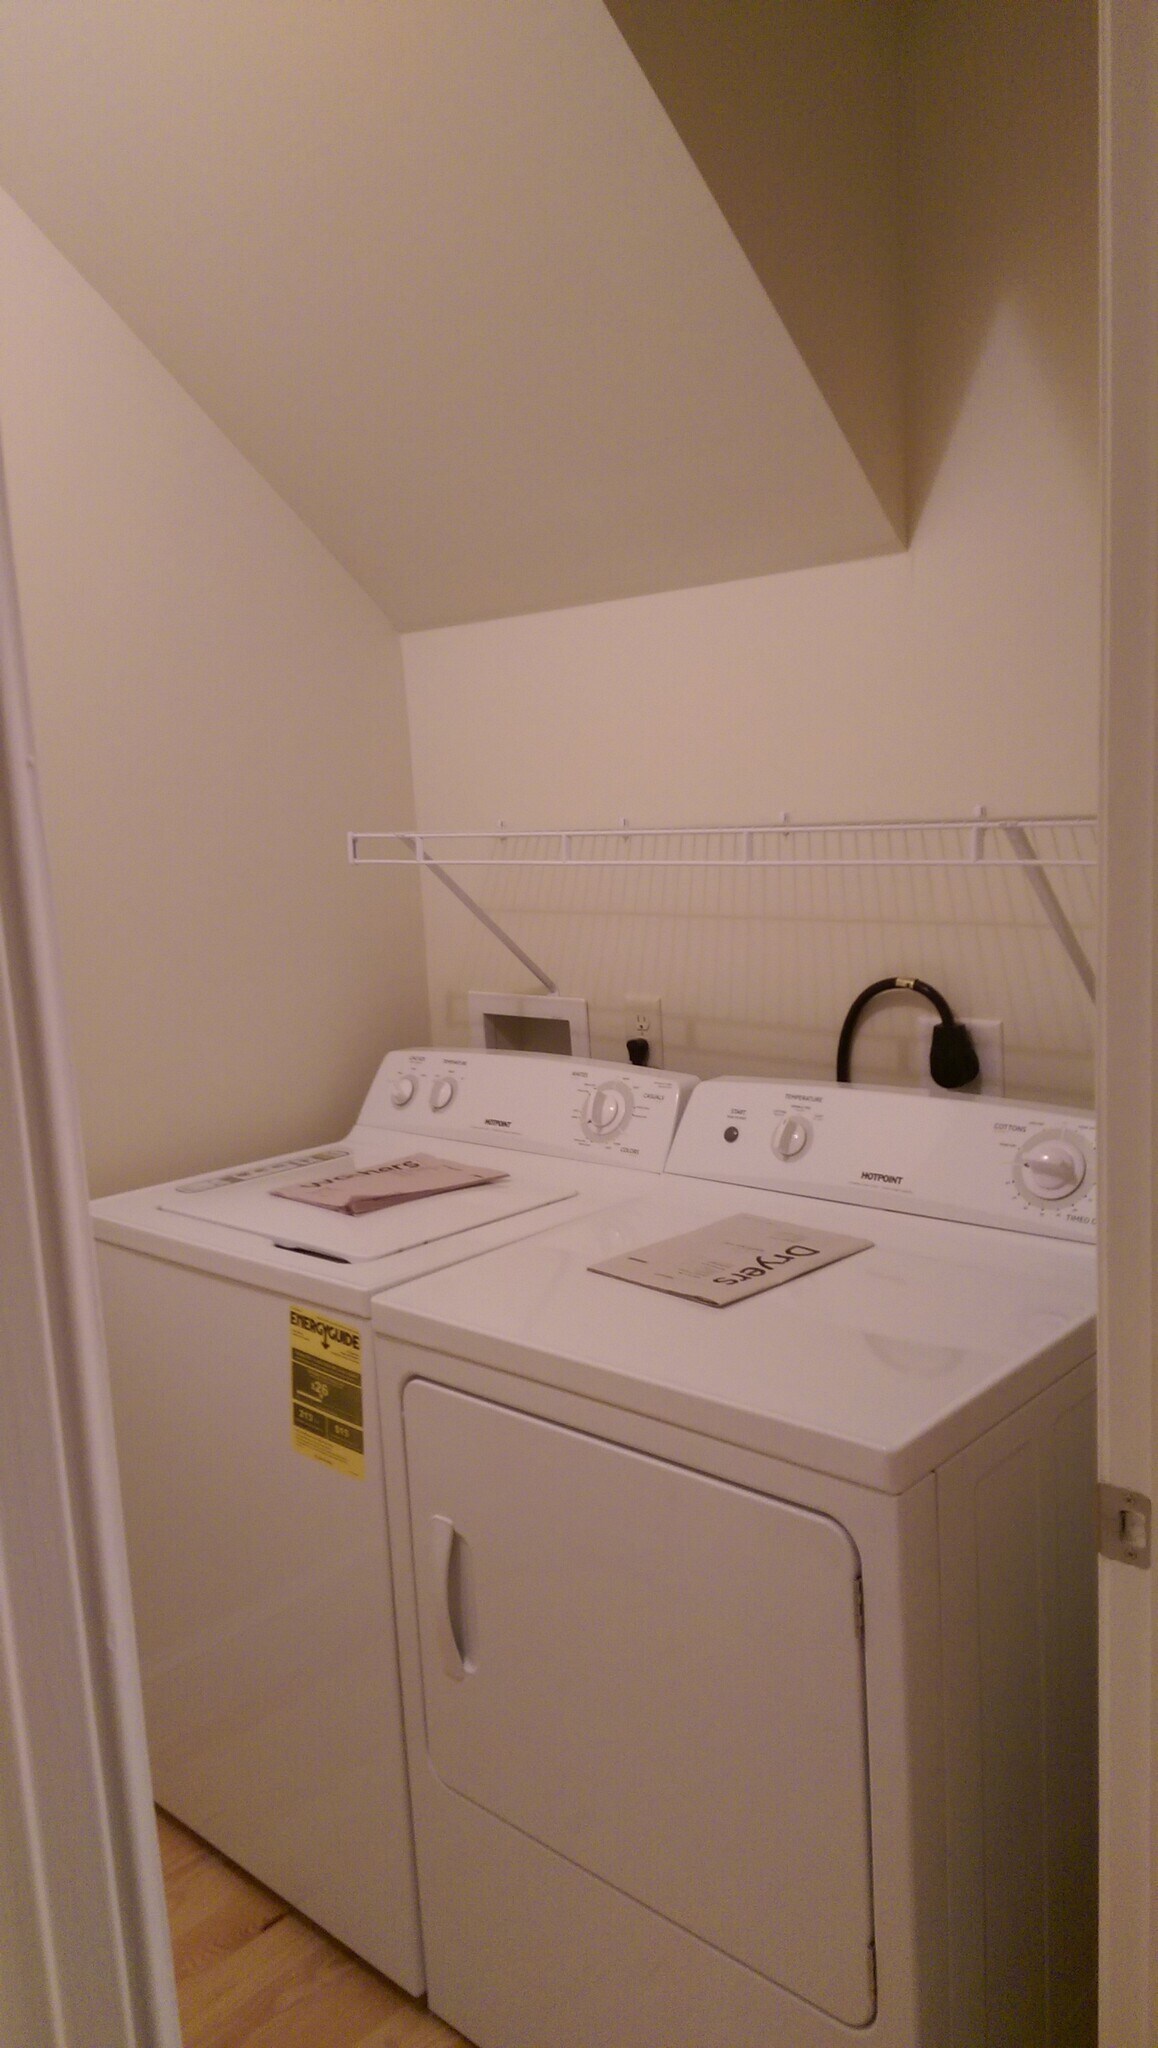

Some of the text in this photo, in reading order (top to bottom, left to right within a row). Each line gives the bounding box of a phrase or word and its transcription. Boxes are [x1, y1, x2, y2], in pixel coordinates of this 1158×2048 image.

[785, 1093, 823, 1103] TEMPERATURE
[484, 1118, 512, 1128] HOTPOINT
[993, 1122, 1027, 1133] COTTONS
[860, 1171, 904, 1185] HOTPOINT
[712, 1244, 821, 1286] Dryers
[290, 1310, 360, 1351] ENERGYGUIDE
